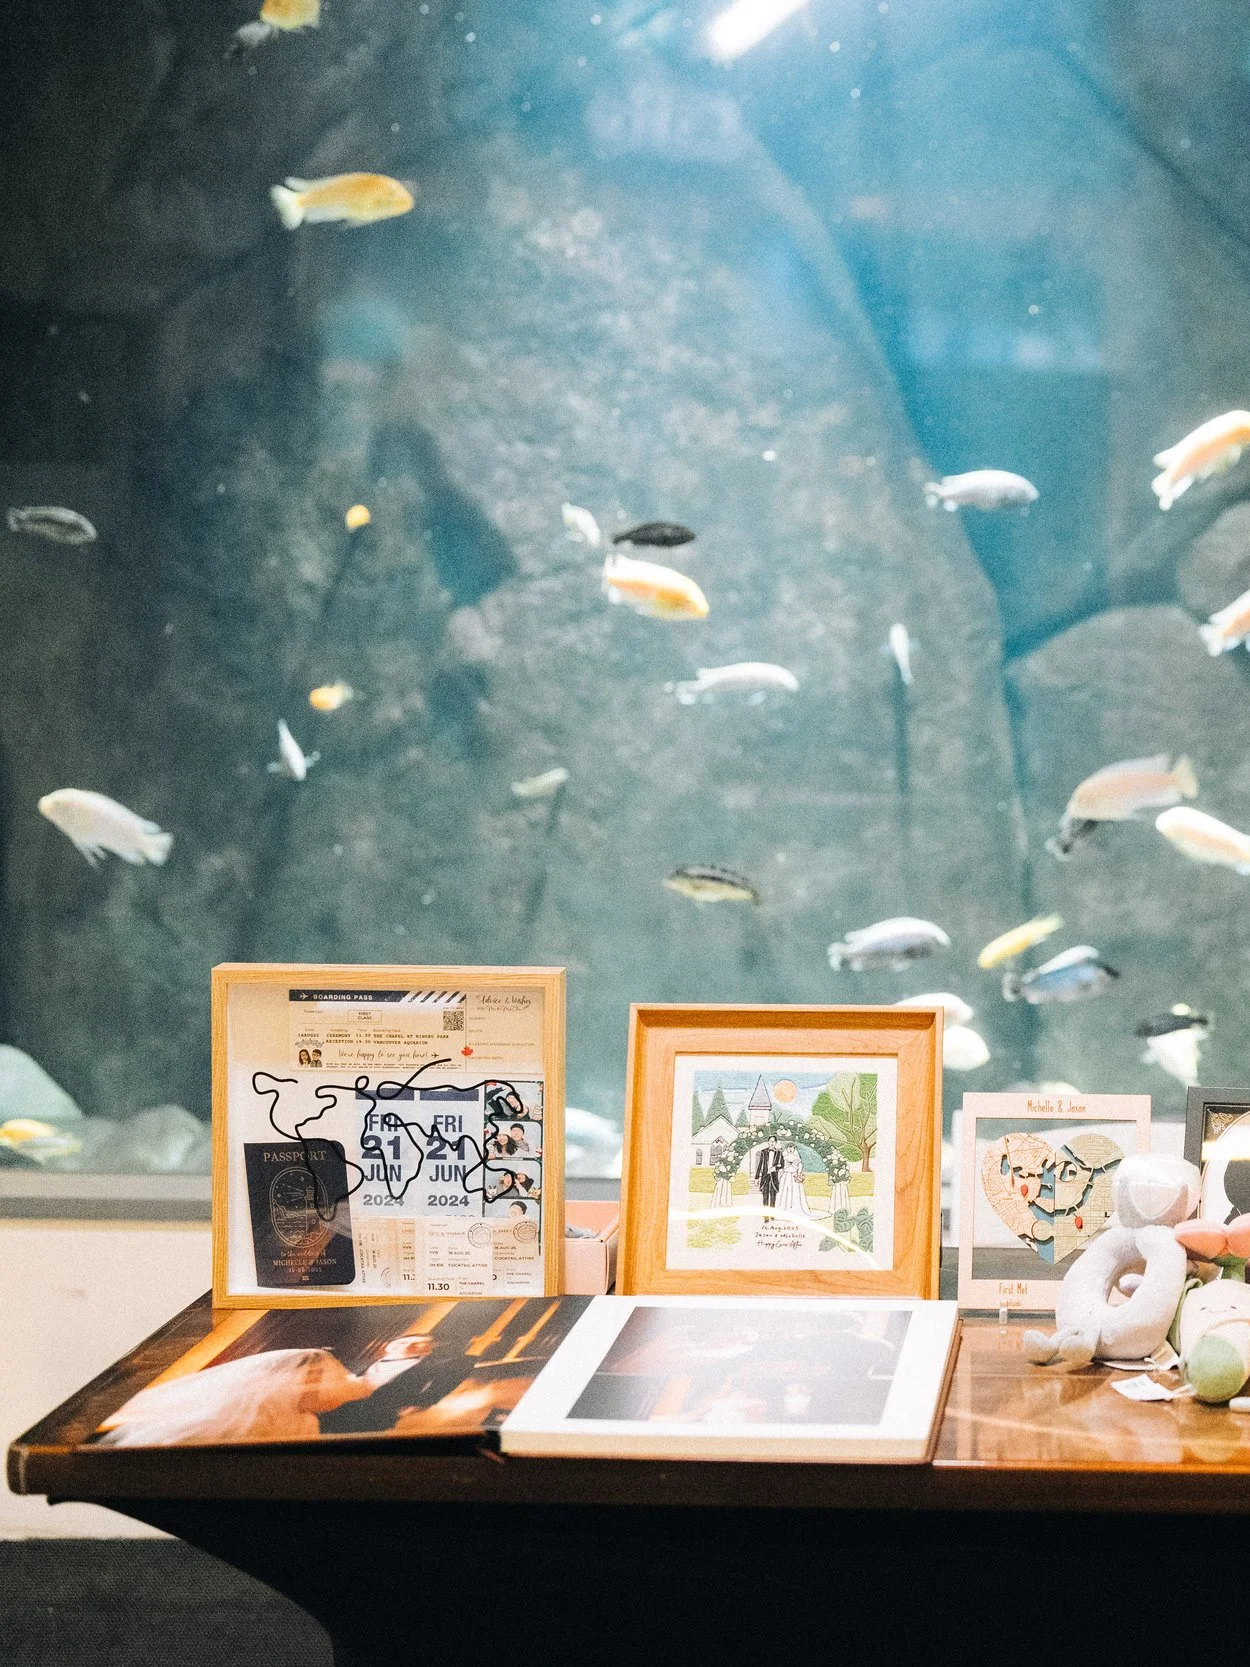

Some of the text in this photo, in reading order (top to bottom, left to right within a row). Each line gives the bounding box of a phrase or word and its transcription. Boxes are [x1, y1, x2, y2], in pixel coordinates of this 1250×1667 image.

[357, 1049, 374, 1061] happy
[399, 1053, 410, 1061] you
[1027, 1100, 1086, 1112] Michelle & Jason
[368, 1114, 398, 1132] FRI
[433, 1115, 463, 1132] FRI
[362, 1135, 400, 1159] 21
[426, 1136, 466, 1160] 21
[364, 1164, 401, 1182] JUN
[429, 1165, 466, 1182] JUN
[363, 1194, 404, 1206] 2024
[428, 1195, 469, 1206] 2024
[999, 1283, 1027, 1294] First Met
